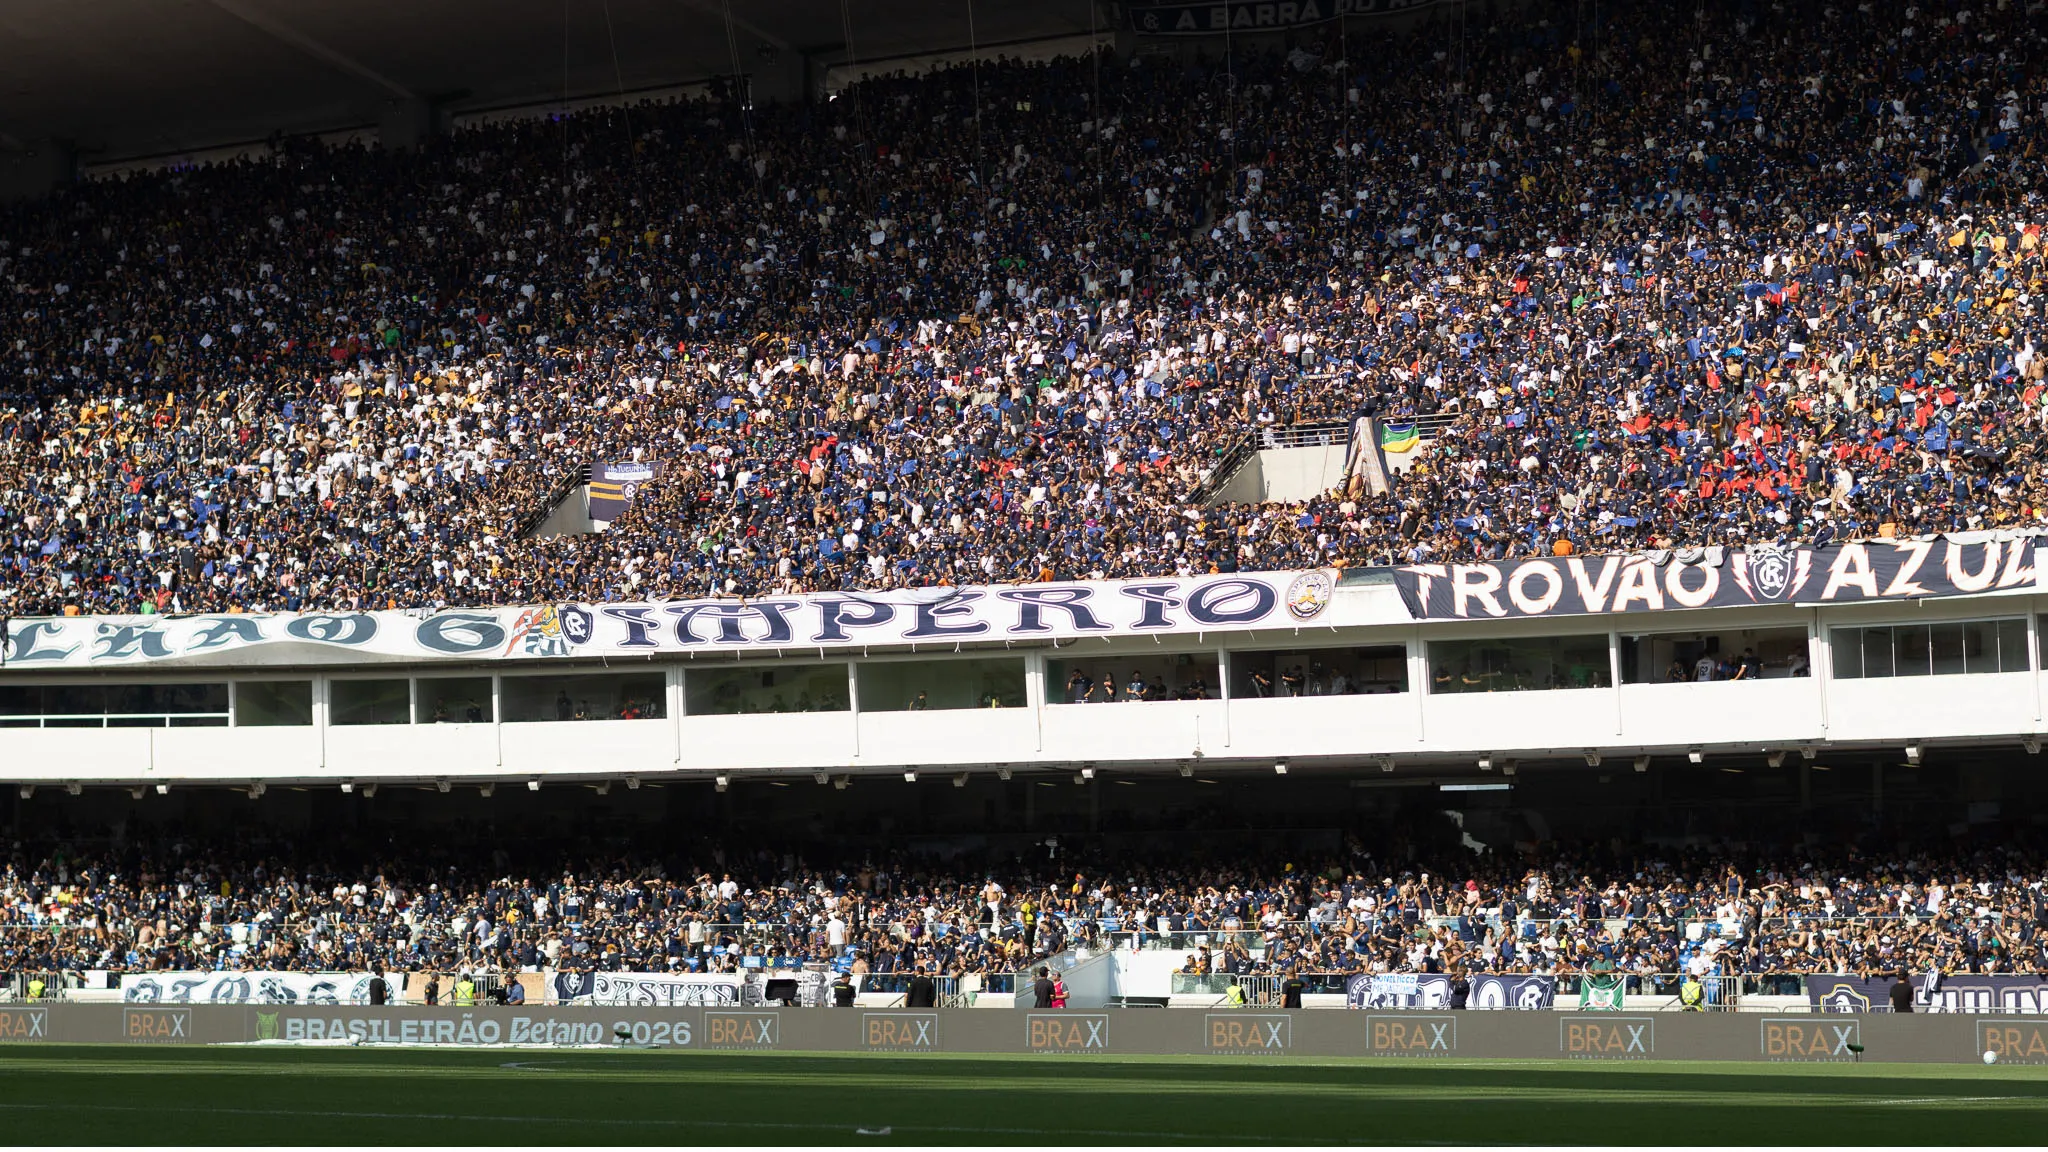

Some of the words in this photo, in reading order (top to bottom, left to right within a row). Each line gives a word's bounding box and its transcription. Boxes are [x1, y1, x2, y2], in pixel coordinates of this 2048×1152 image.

[1209, 0, 1321, 28] BARRA
[1821, 537, 2037, 599] AZUL
[130, 1014, 185, 1037] BRAX
[286, 1014, 501, 1043] BRASILEIRÃO
[510, 1016, 603, 1043] Betano
[612, 1021, 691, 1045] 2026
[711, 1018, 772, 1044] BRAX
[869, 1020, 931, 1046] BRAX
[1031, 1020, 1103, 1048] BRAX
[1212, 1021, 1284, 1048] BRAX
[1374, 1022, 1448, 1049] BRAX
[1568, 1024, 1646, 1052] BRAX
[1767, 1025, 1854, 1056] BRAX
